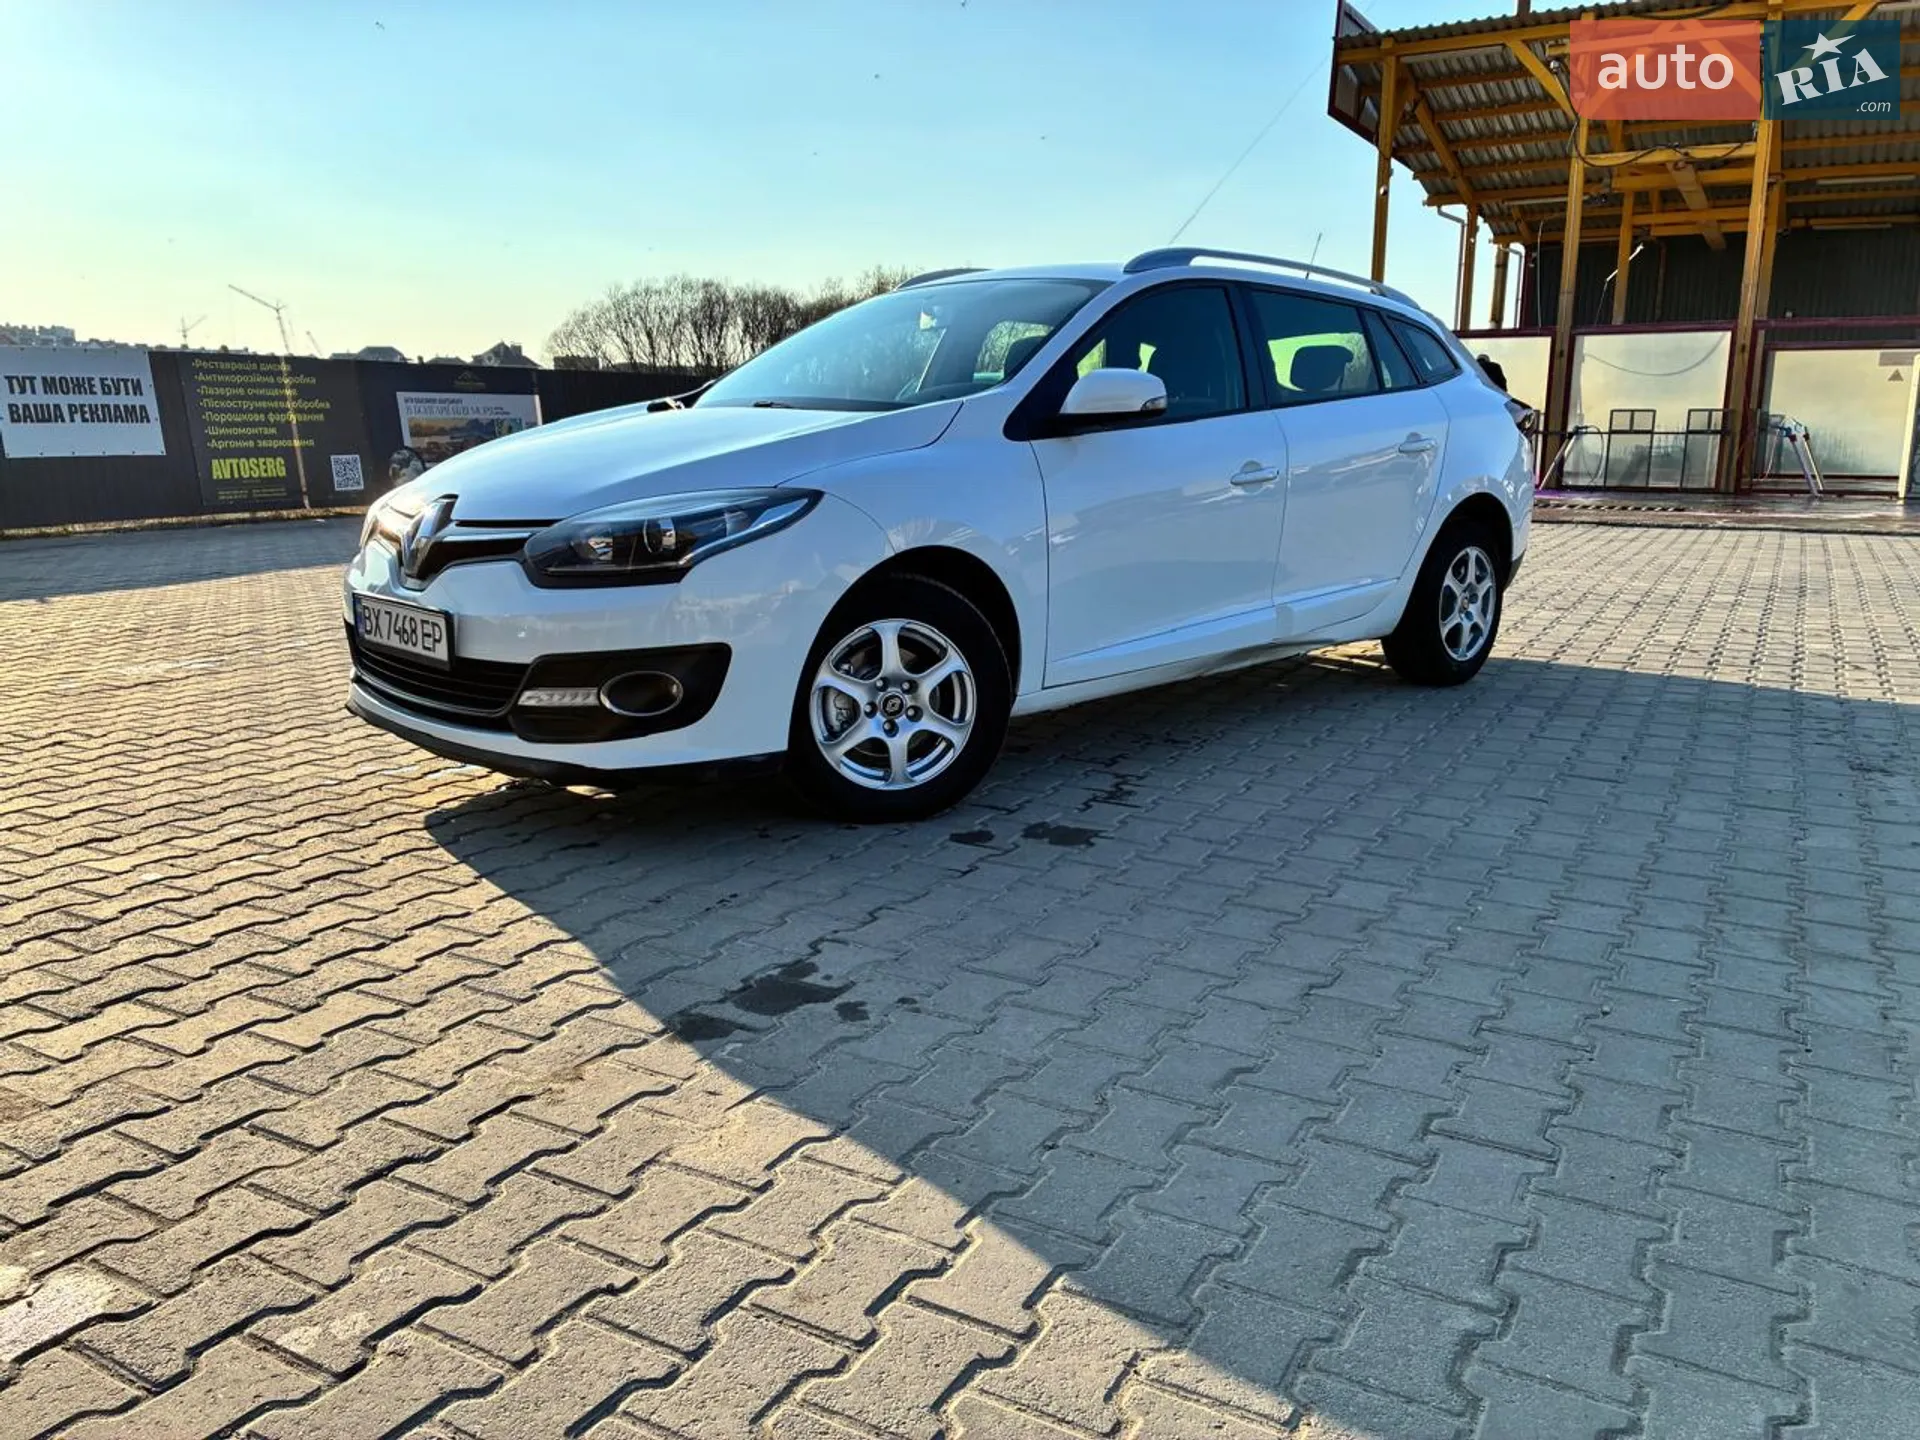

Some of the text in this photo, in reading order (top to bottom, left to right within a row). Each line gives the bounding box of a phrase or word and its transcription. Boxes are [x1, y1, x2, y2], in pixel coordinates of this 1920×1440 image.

[4, 375, 143, 397] ТУТ МОЖЕ БУТИ
[8, 403, 151, 424] ВАША РЕКЛАМА
[211, 456, 287, 479] AVTOSERG
[362, 604, 443, 652] BX 7468 EP
